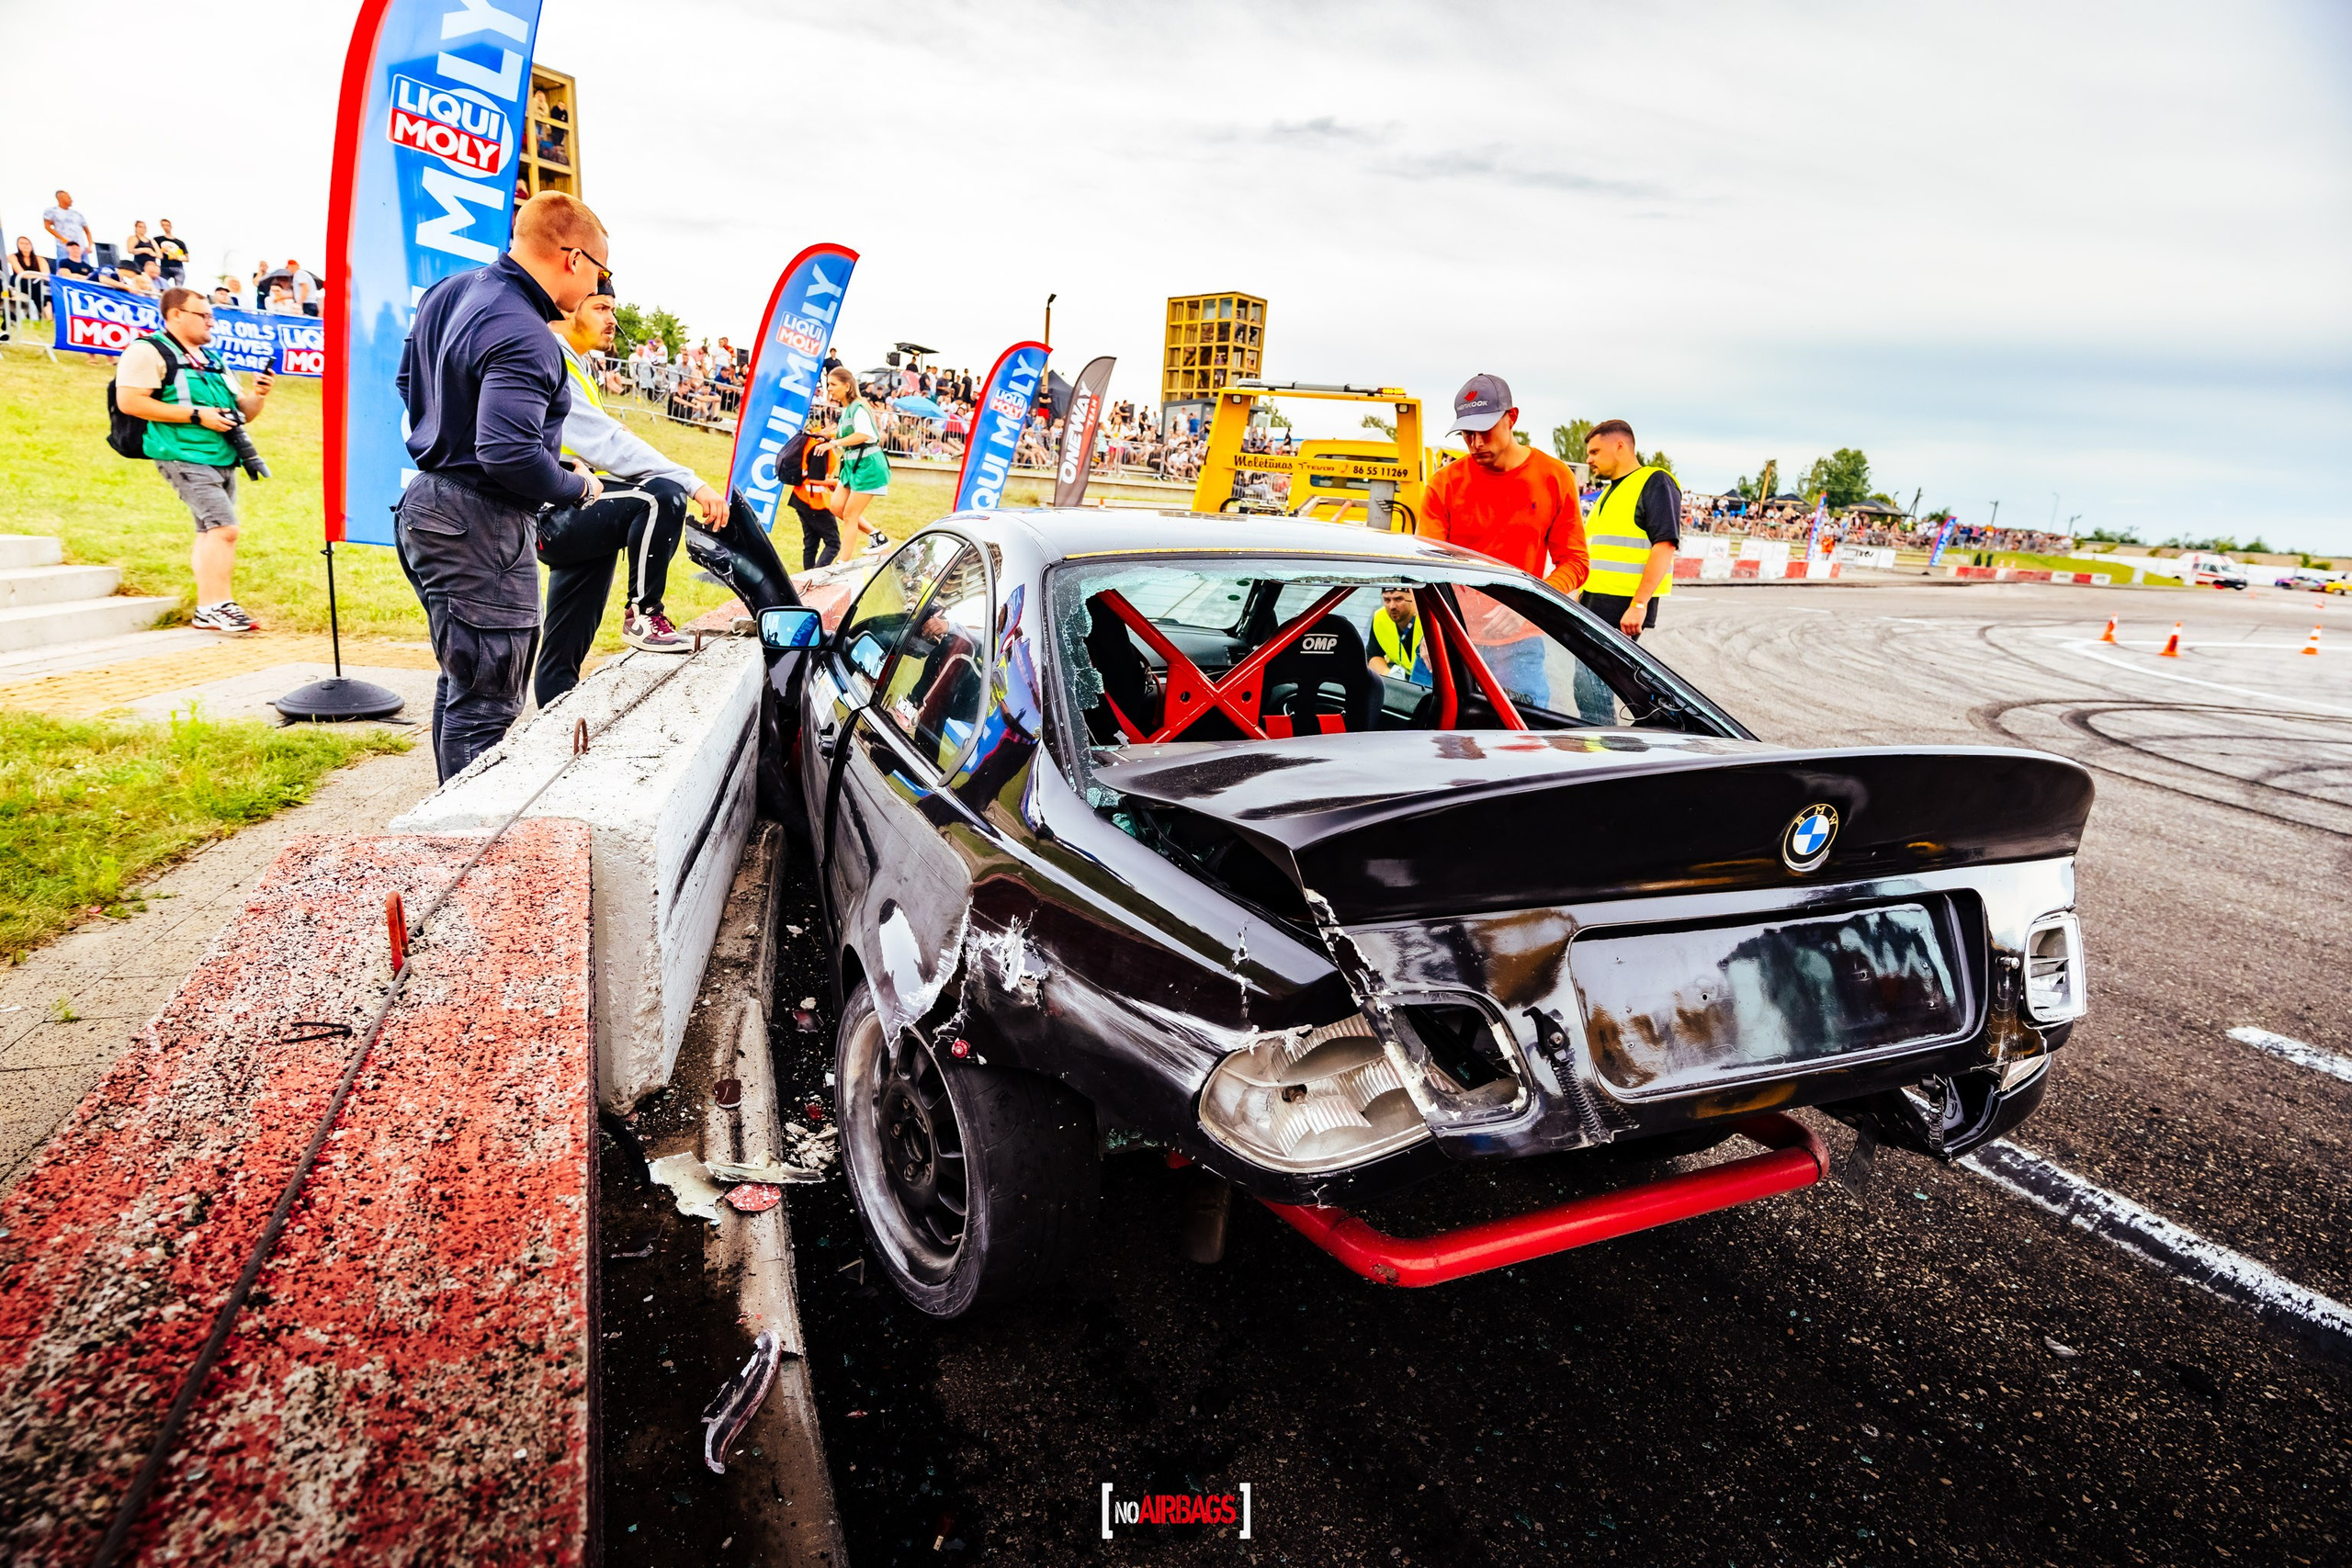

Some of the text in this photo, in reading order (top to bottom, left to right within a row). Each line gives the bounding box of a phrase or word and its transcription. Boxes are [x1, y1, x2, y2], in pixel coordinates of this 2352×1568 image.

[398, 80, 500, 140] LIQUI
[393, 112, 500, 169] MOLY
[69, 291, 160, 329] LIQUI
[234, 321, 276, 340] OILS
[784, 313, 823, 340] LIQUI
[282, 328, 324, 351] LIQ
[778, 329, 821, 355] MOLY
[286, 350, 324, 373] MO
[991, 398, 1023, 419] MOLY
[995, 389, 1025, 409] LIQUI
[1086, 399, 1098, 431] TEAM
[1058, 380, 1092, 485] ONEWAY
[1353, 465, 1408, 478] 86 55 11269
[1302, 637, 1338, 650] OMP
